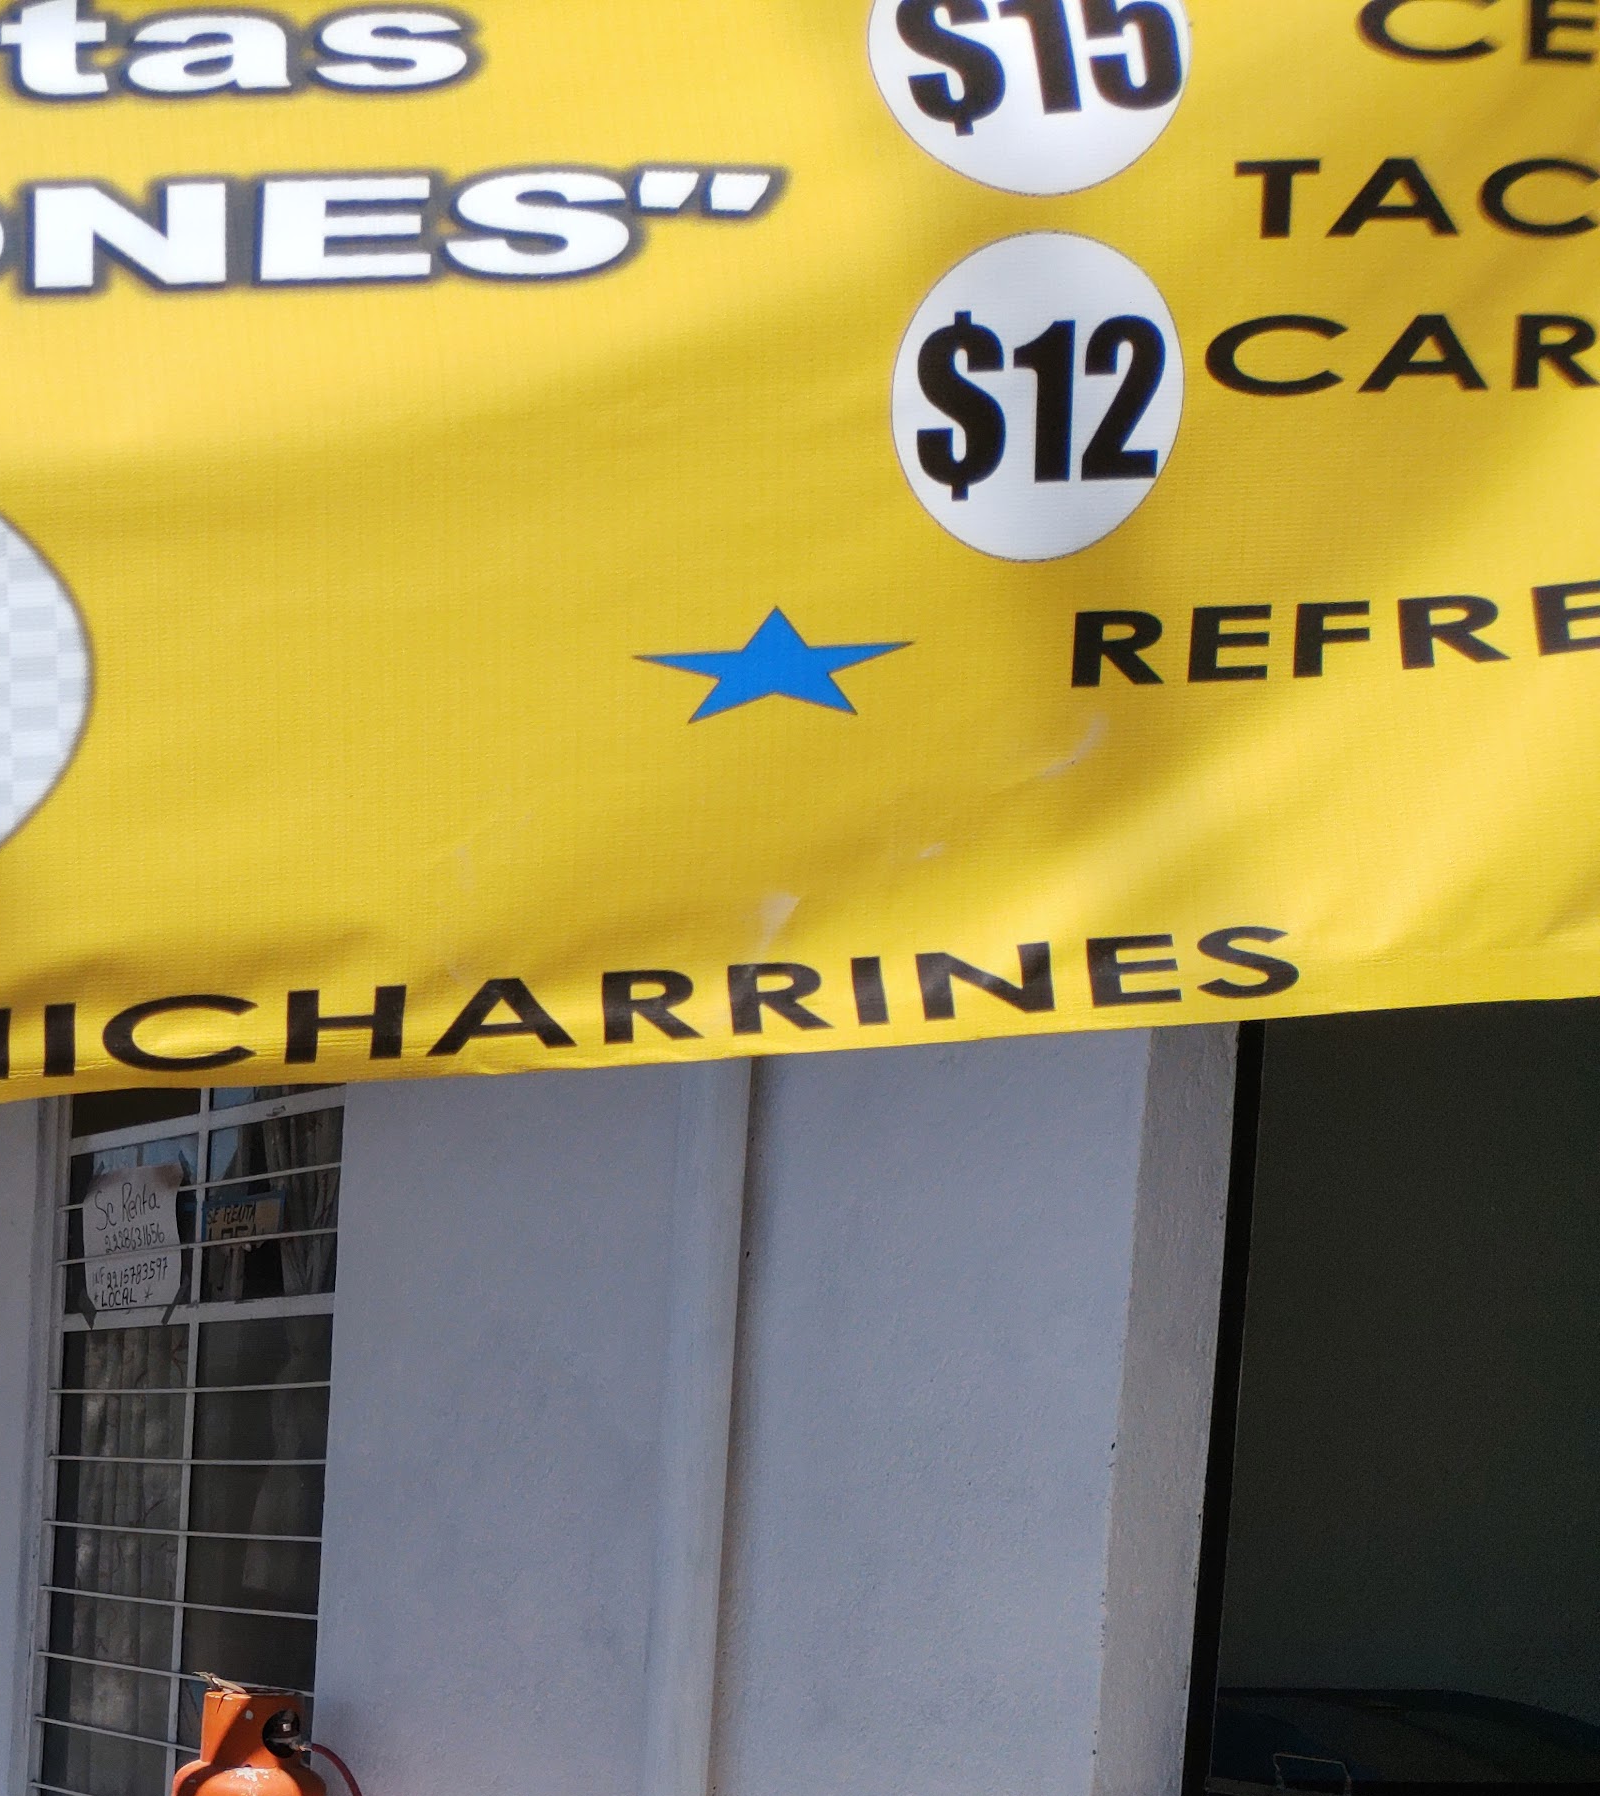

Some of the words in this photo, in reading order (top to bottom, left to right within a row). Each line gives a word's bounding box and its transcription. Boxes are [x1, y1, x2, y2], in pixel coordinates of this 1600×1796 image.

[895, 0, 1182, 135] $15
[1357, 0, 1597, 64] CE
[1235, 156, 1600, 240] TAC
[1204, 312, 1599, 397] CAR
[916, 311, 1163, 501] $12
[1071, 579, 1600, 688] REFRE
[101, 1287, 138, 1308] LOCAL
